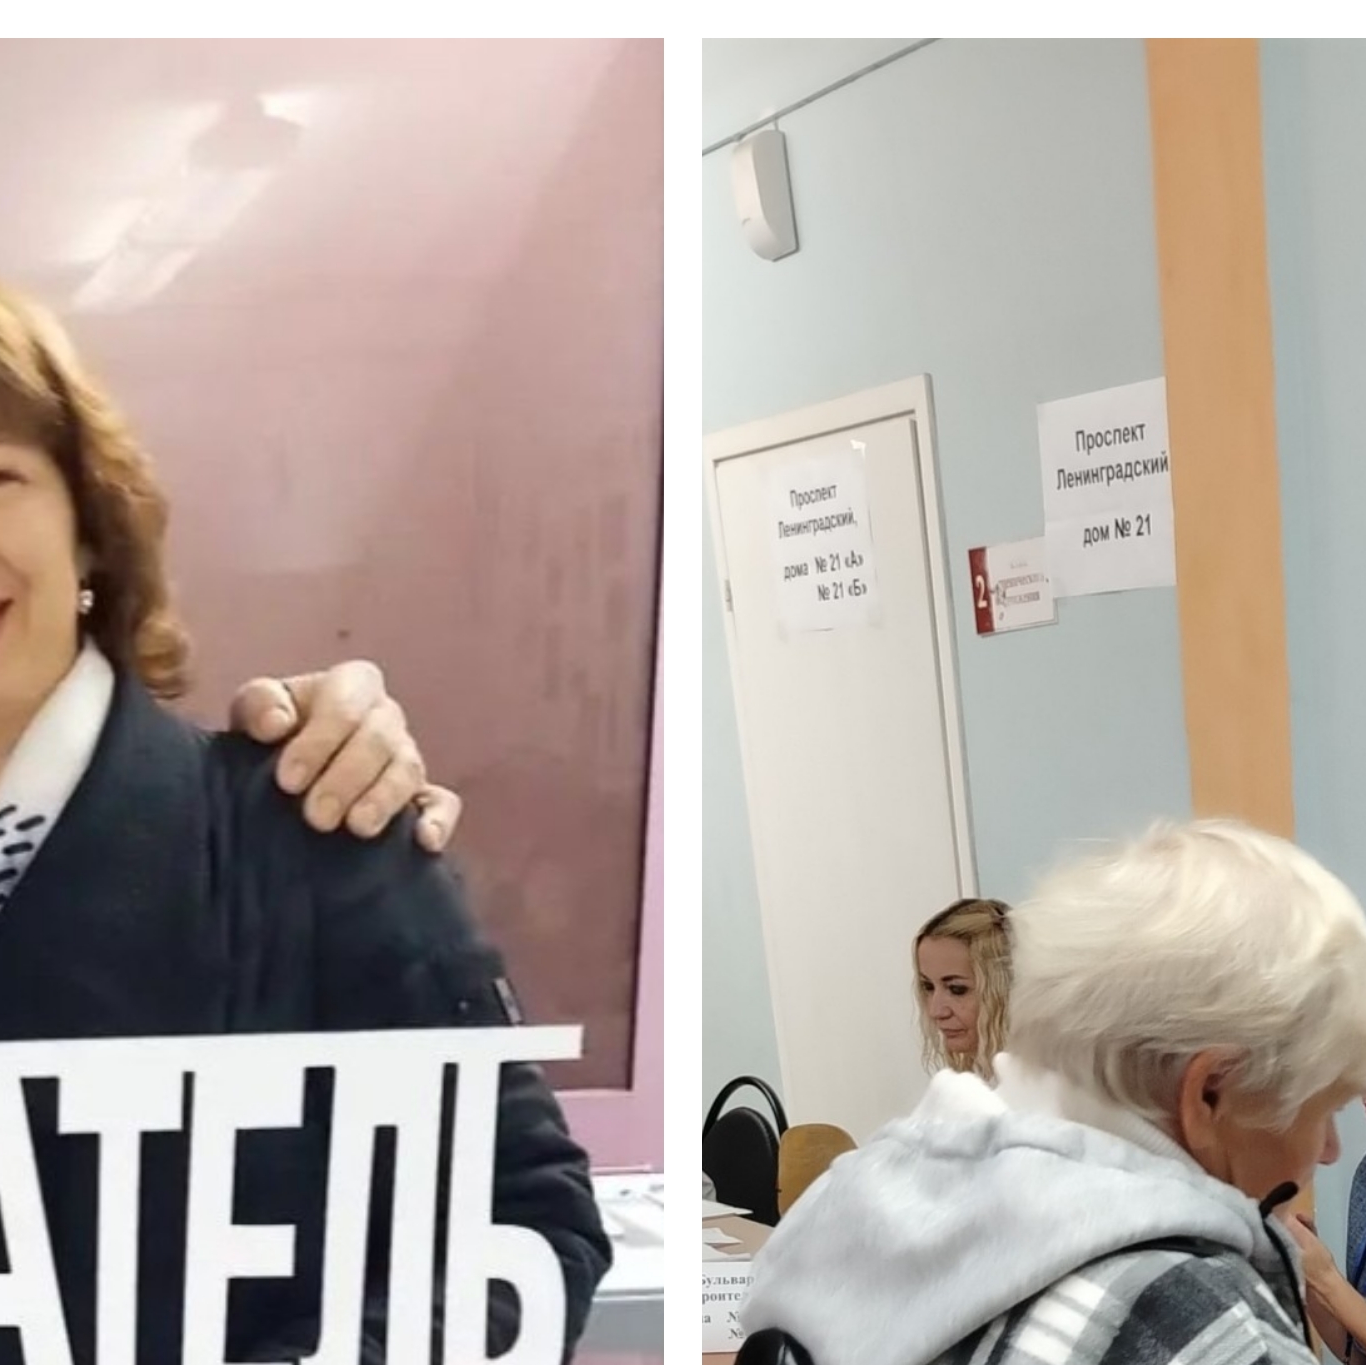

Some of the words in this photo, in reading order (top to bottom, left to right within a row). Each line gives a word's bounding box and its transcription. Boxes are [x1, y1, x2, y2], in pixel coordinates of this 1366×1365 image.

[1075, 422, 1146, 455] Проспект
[1056, 452, 1169, 491] Ленинградский
[790, 484, 837, 510] Проспект
[778, 508, 858, 540] Ленинградский,
[1082, 526, 1109, 547] дом
[1113, 517, 1132, 538] №
[1135, 513, 1151, 536] 21
[784, 560, 809, 582] дома
[815, 554, 827, 573] №
[830, 554, 842, 572] 21
[845, 549, 864, 569] «А»
[817, 583, 830, 601] №
[833, 581, 845, 599] 21
[847, 578, 867, 597] «Б»
[976, 574, 987, 608] 2
